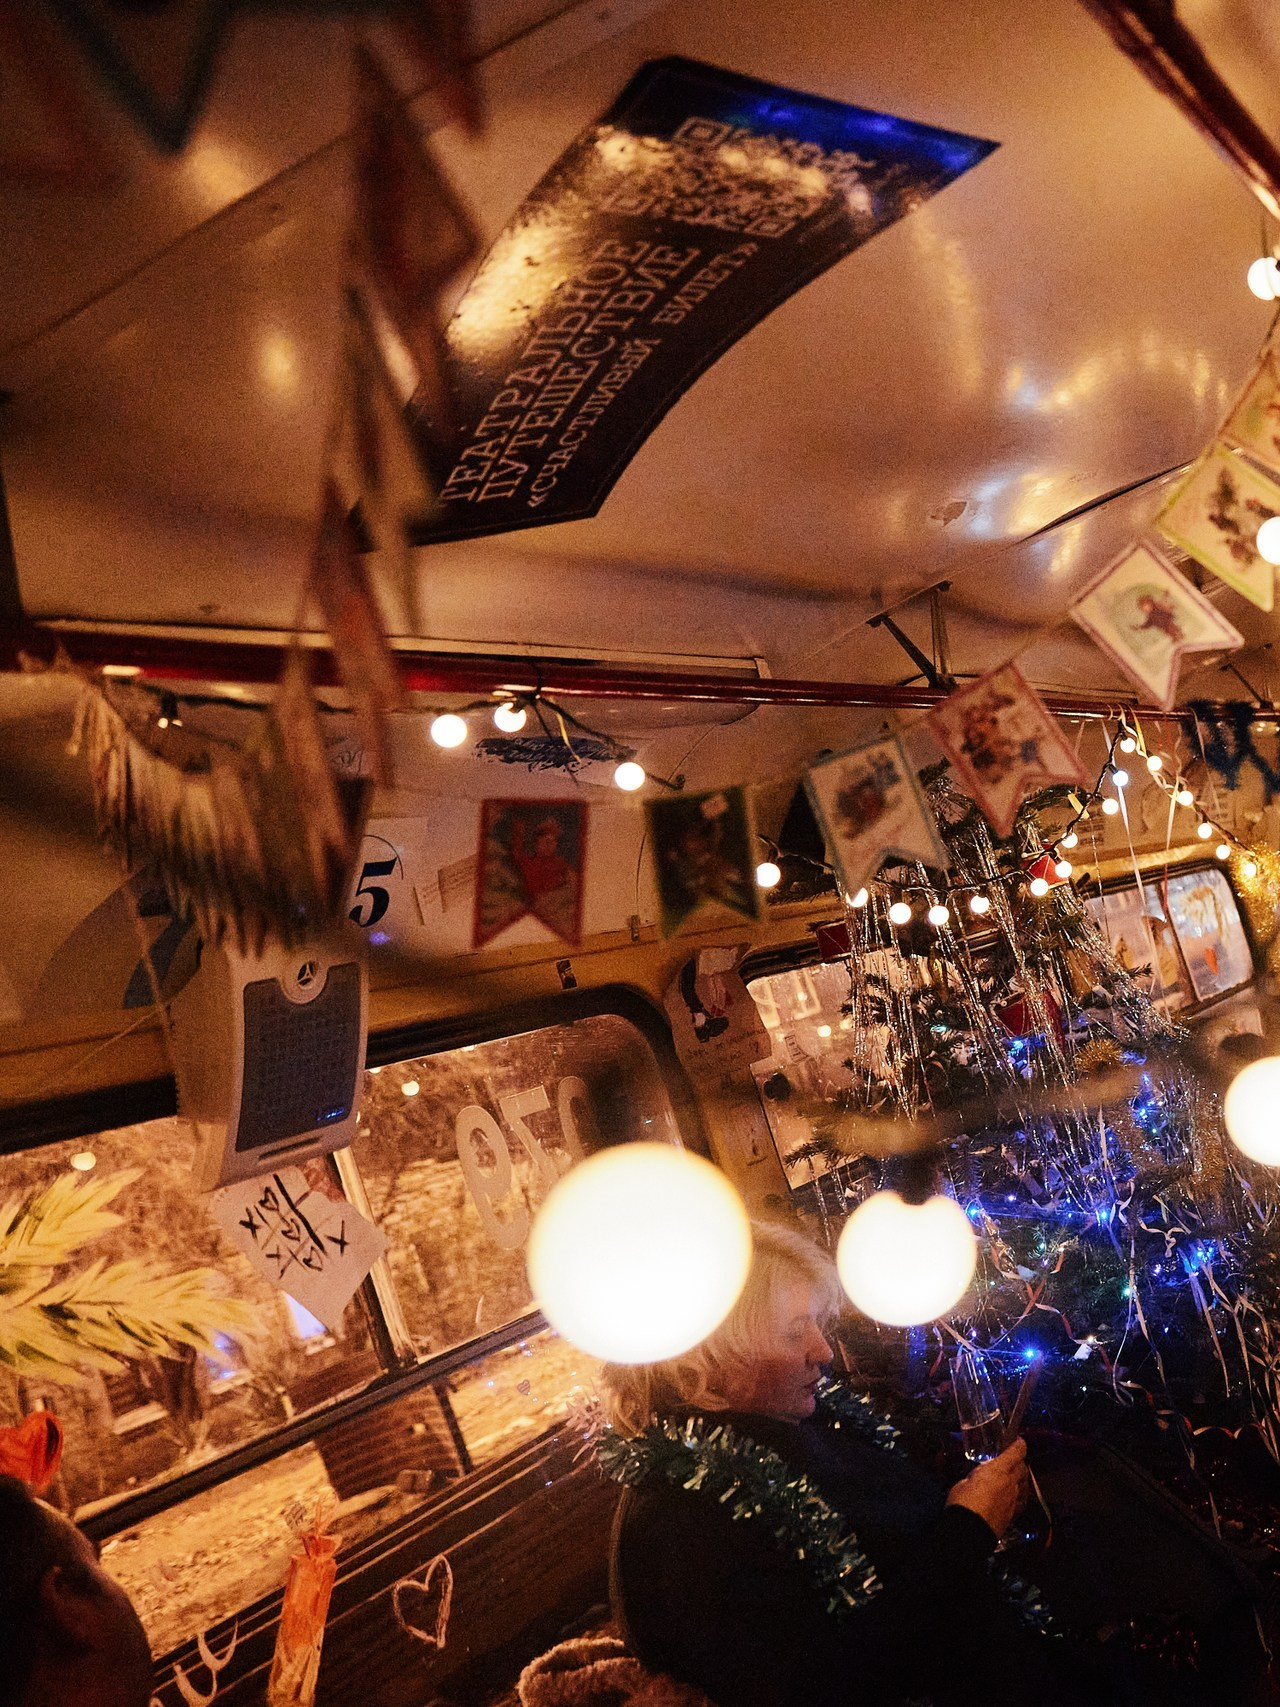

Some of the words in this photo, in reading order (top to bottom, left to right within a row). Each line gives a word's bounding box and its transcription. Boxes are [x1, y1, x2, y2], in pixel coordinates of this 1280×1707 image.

[439, 240, 645, 507] ТЕАТРАЛЬНОЕ
[477, 243, 699, 503] ПУТЕШЕСТВИЕ
[348, 856, 397, 928] 5
